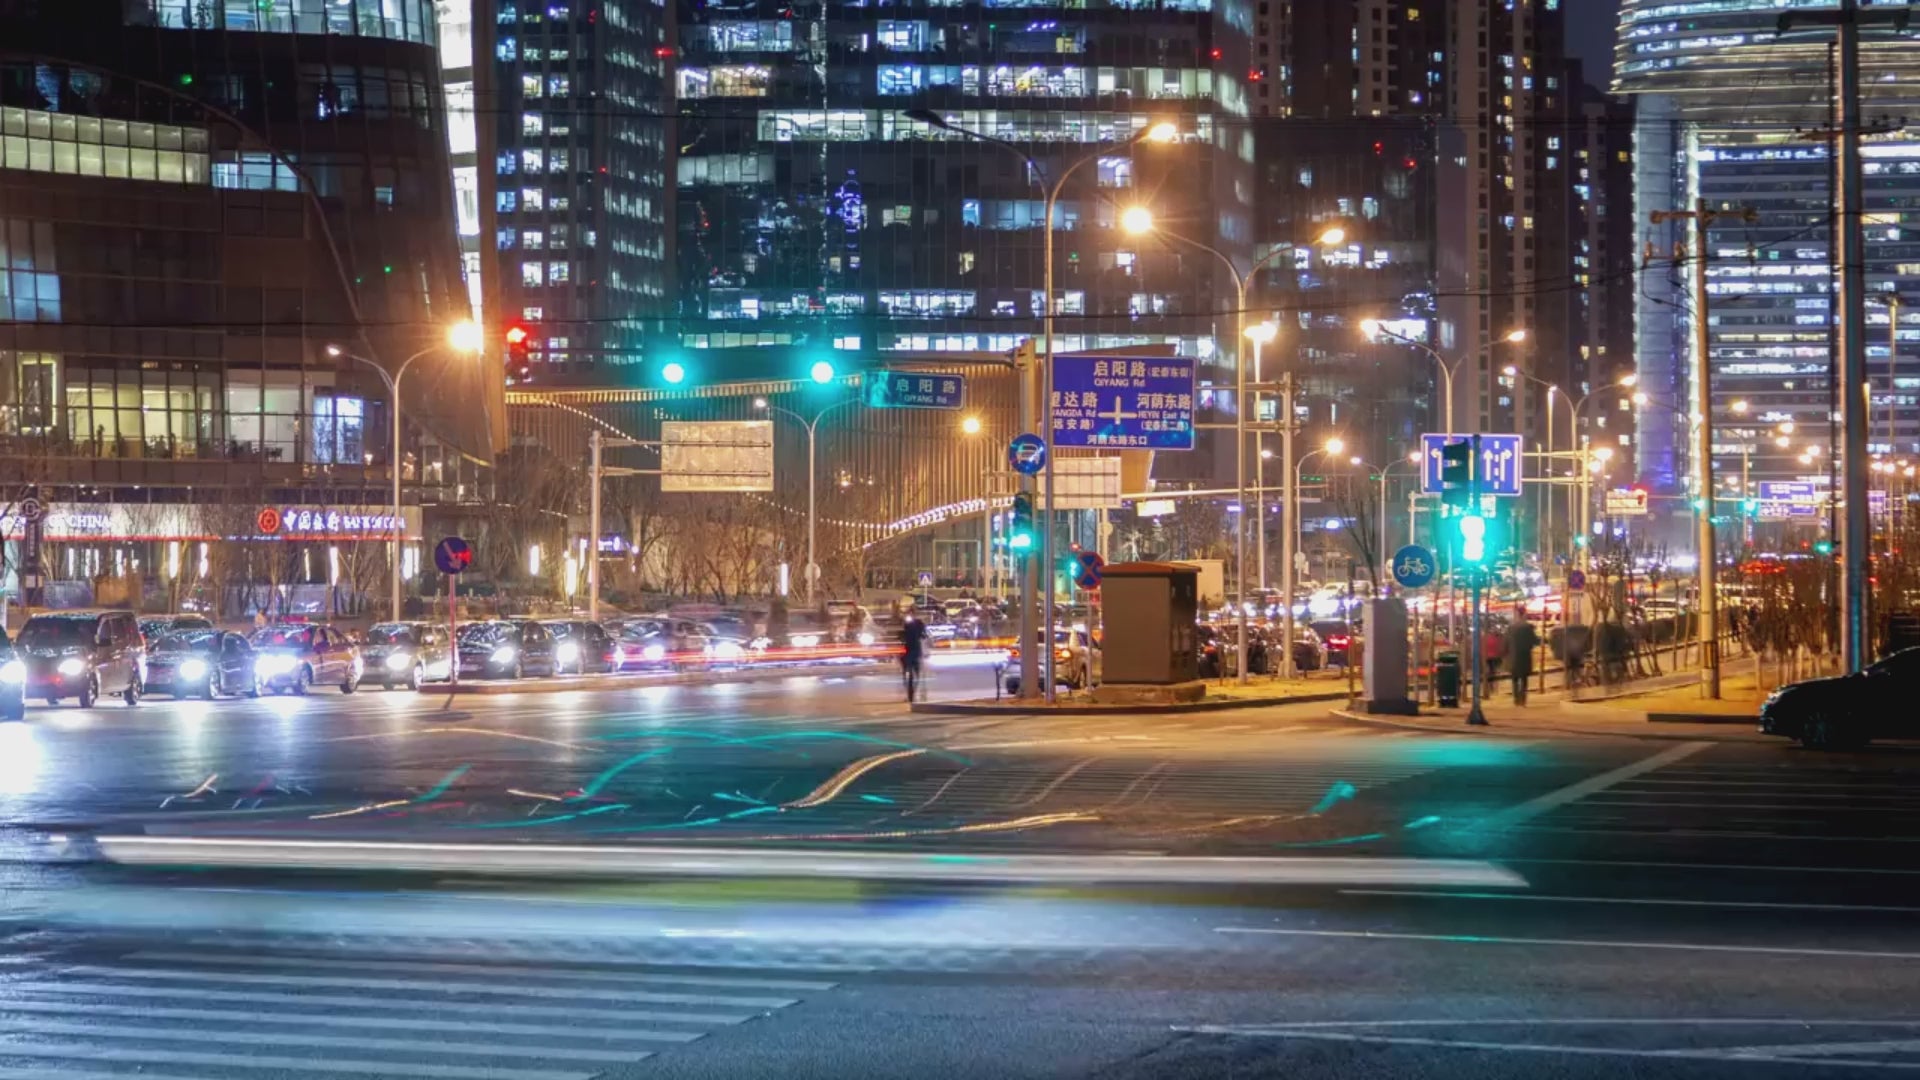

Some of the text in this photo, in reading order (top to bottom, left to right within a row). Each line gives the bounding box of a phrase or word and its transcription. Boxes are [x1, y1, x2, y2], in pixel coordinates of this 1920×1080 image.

[1094, 361, 1145, 377] 启阳路
[895, 379, 955, 394] 启阳路
[1094, 379, 1146, 387] QIYANG Rd
[1137, 393, 1191, 409] 河荫东路
[1053, 409, 1096, 417] ANGDA Rd
[1162, 411, 1177, 419] East
[1180, 411, 1190, 419] Rd
[69, 515, 112, 528] CHINA
